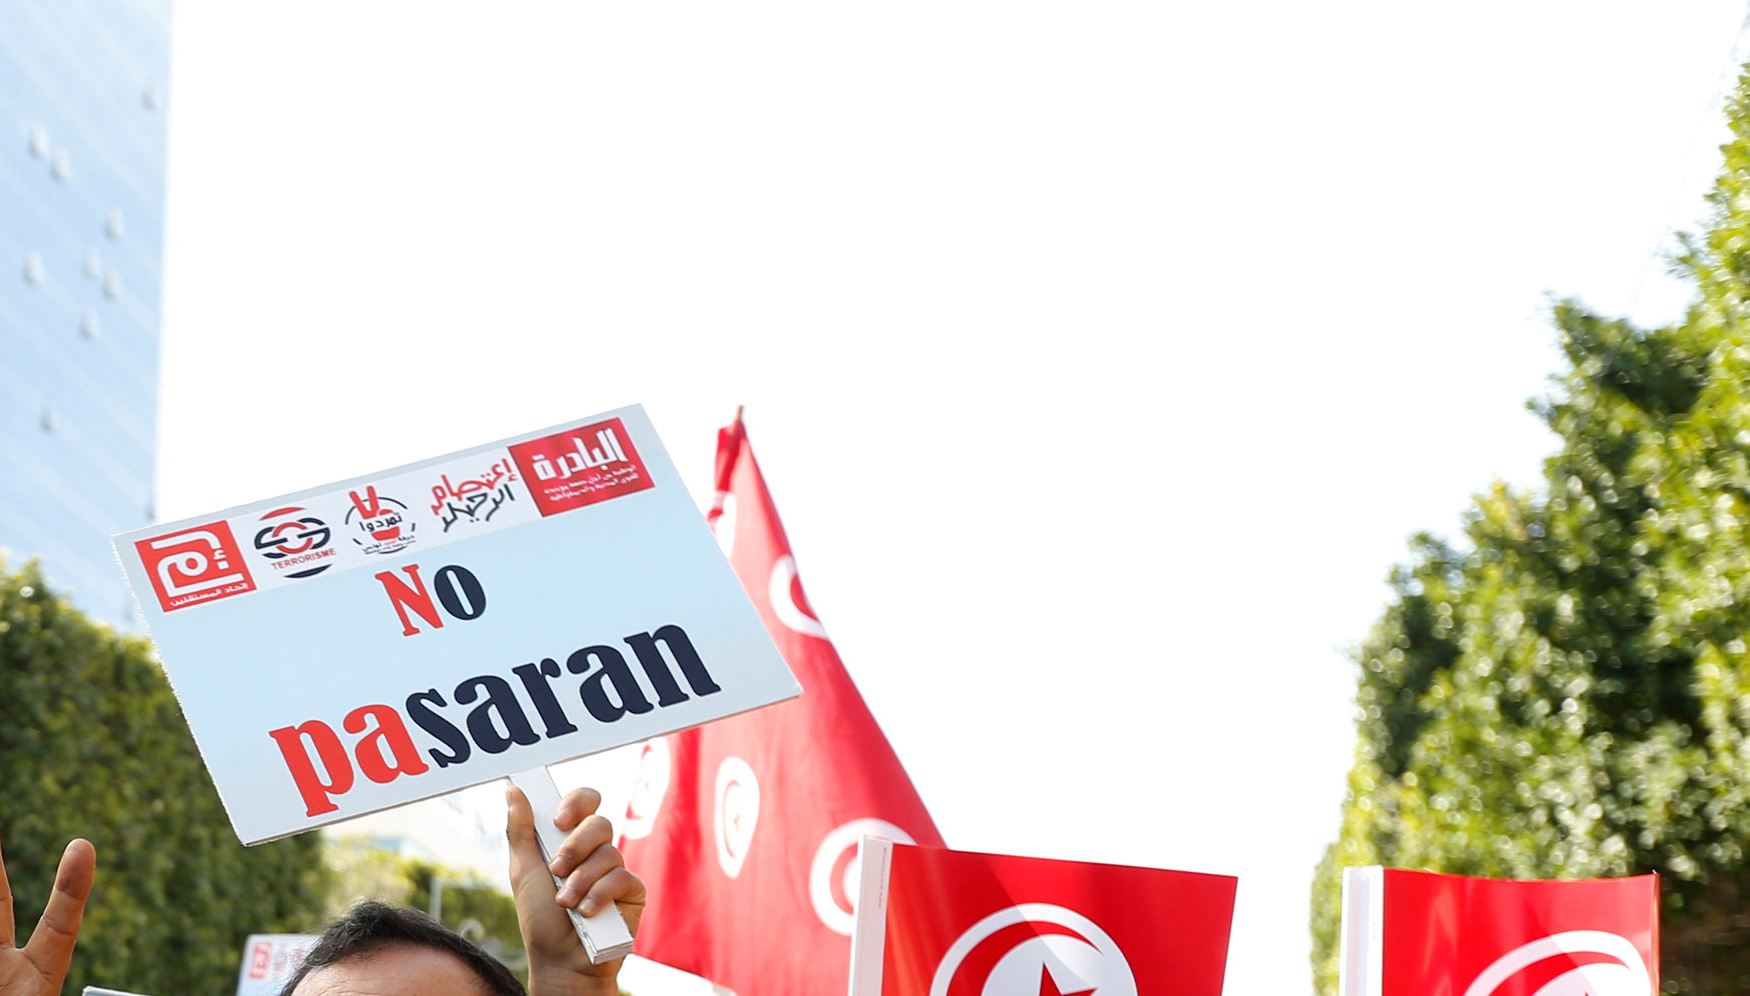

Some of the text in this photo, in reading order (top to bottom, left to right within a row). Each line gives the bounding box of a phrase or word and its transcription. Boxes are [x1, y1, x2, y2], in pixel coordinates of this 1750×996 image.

[270, 548, 337, 570] TERRORISME
[375, 564, 487, 636] No
[268, 624, 721, 817] pasaran
